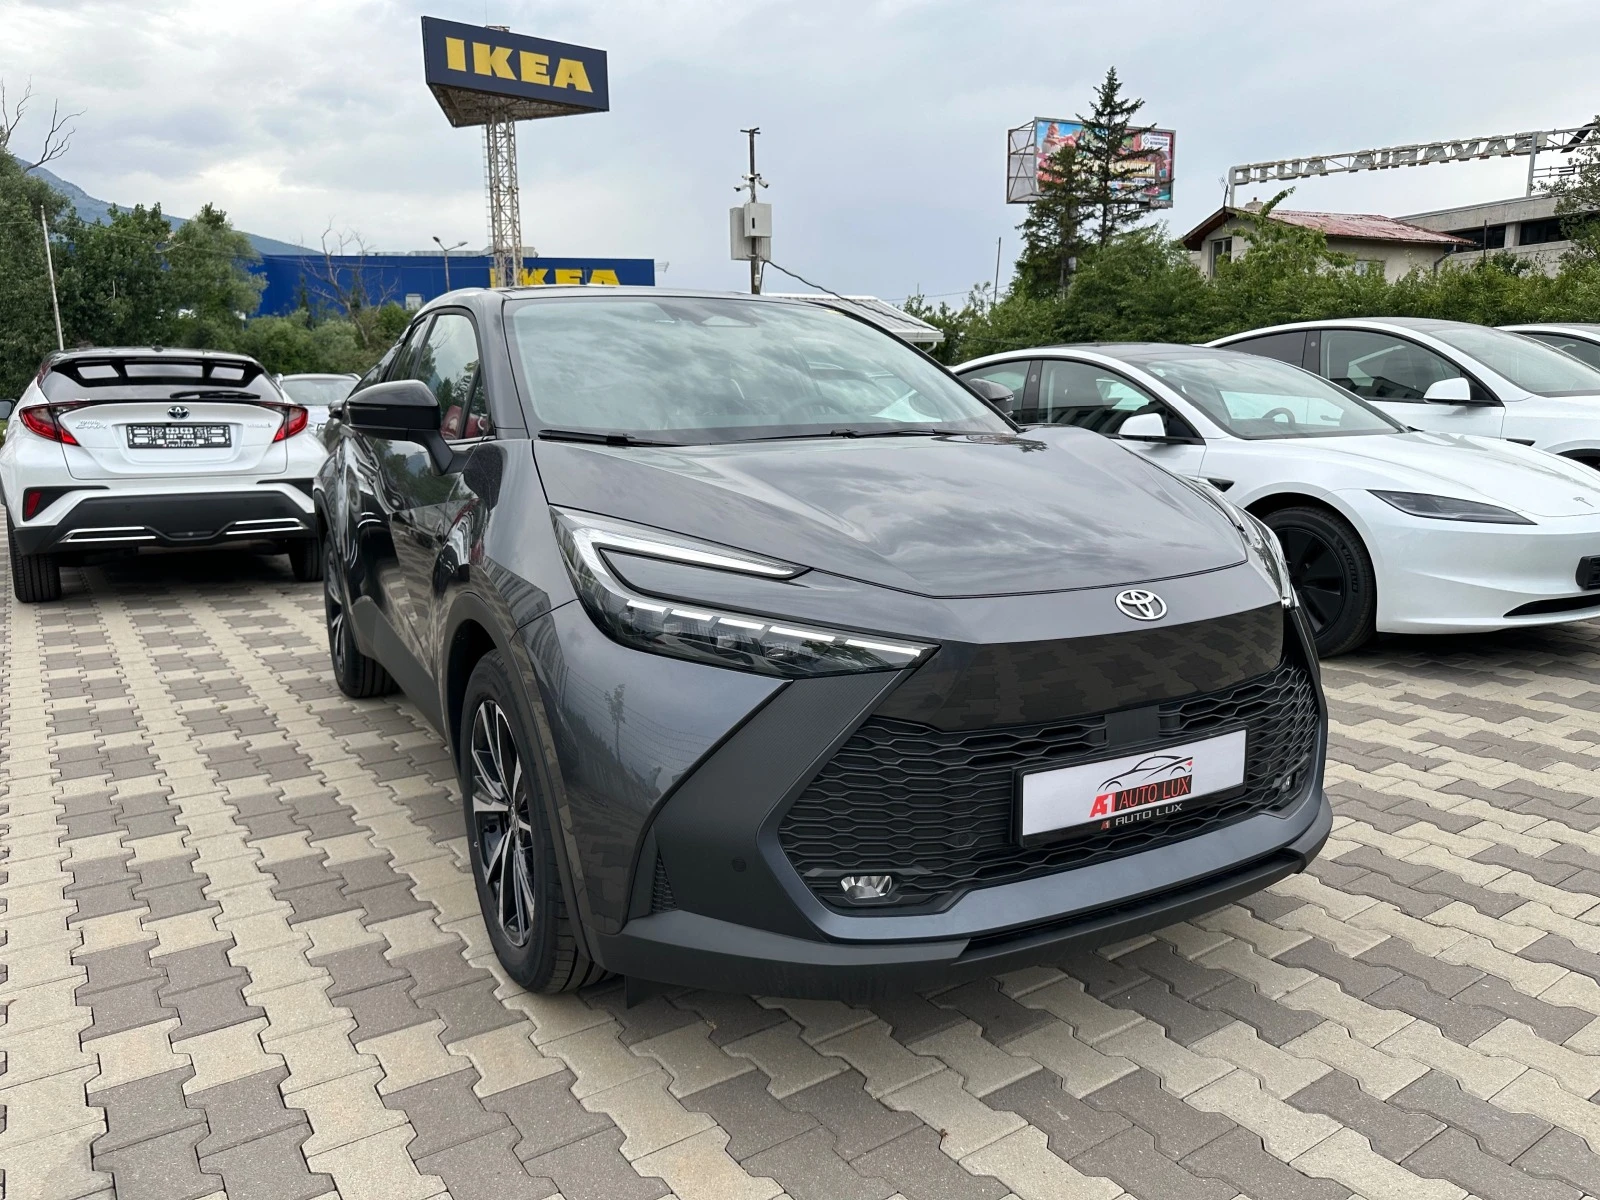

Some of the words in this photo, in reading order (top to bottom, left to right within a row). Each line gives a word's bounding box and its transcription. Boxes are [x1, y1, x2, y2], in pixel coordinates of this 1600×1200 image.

[445, 36, 593, 93] IKEA
[1089, 792, 1116, 818] A1
[1119, 782, 1158, 810] AUTO
[1163, 776, 1190, 800] LUX
[1115, 811, 1152, 826] AUTO
[1157, 803, 1183, 816] LUX
